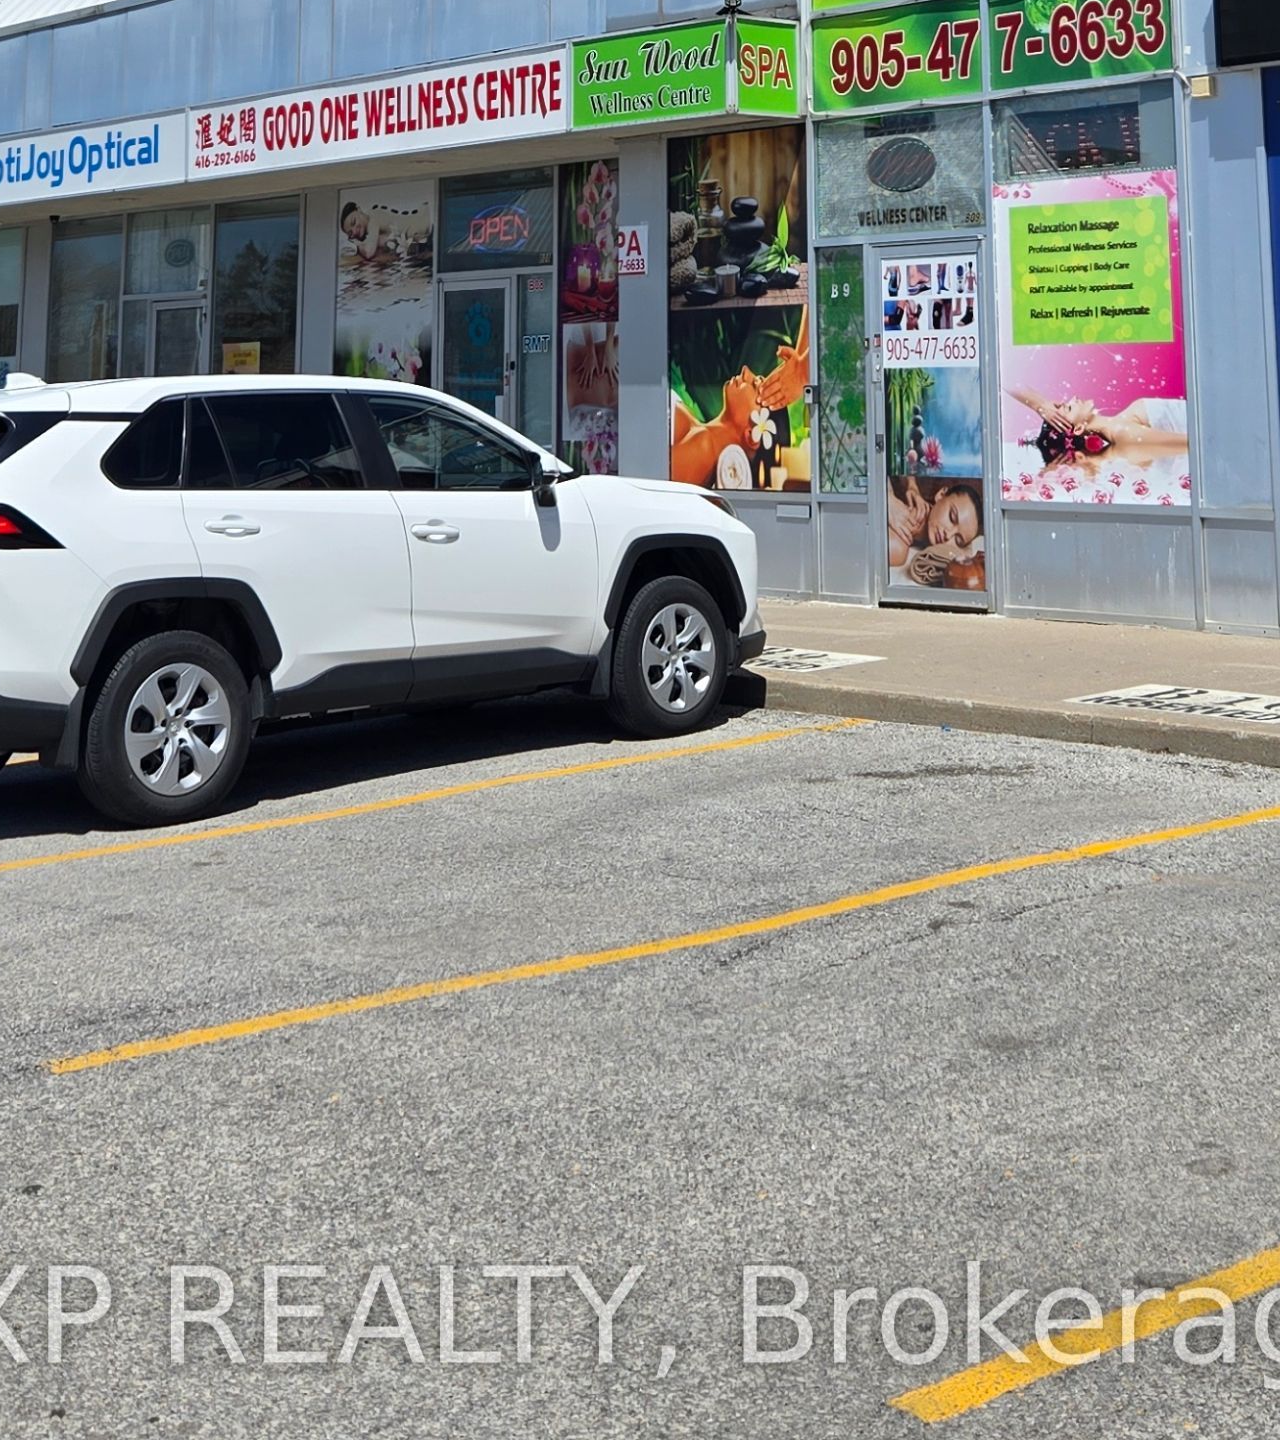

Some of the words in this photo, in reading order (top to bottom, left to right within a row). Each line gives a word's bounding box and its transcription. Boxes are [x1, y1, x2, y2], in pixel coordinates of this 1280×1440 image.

[578, 49, 631, 85] Sun
[638, 32, 721, 77] Wood
[738, 43, 793, 90] SPA
[263, 100, 315, 151] GOOD
[320, 93, 359, 144] ONE
[363, 75, 469, 138] WELLNESS
[473, 60, 562, 119] CENTRE
[589, 91, 654, 117] Wellness
[657, 83, 712, 109] Centre
[68, 124, 159, 183] Optical
[195, 149, 256, 168] 416-292-6166
[857, 206, 907, 227] WELLNESS
[909, 205, 947, 223] CENTER
[1028, 221, 1077, 234] Relaxation
[1080, 220, 1120, 232] Massage
[469, 214, 530, 244] OPEN
[617, 230, 642, 256] PA
[1028, 243, 1071, 254] Professional
[1073, 242, 1105, 252] Wellness
[1107, 240, 1137, 250] Services
[1029, 265, 1054, 274] Shiatsu
[1059, 264, 1089, 274] Cupping
[1094, 262, 1112, 272] Body
[1113, 261, 1130, 270] Care
[1047, 284, 1077, 293] Available
[1079, 284, 1087, 293] by
[1089, 282, 1134, 293] appointment
[1030, 309, 1054, 319] Relax
[1060, 307, 1093, 318] Refresh
[1100, 306, 1150, 318] Rejuvenate
[523, 335, 551, 353] RMT
[887, 336, 977, 360] 905-477-6633
